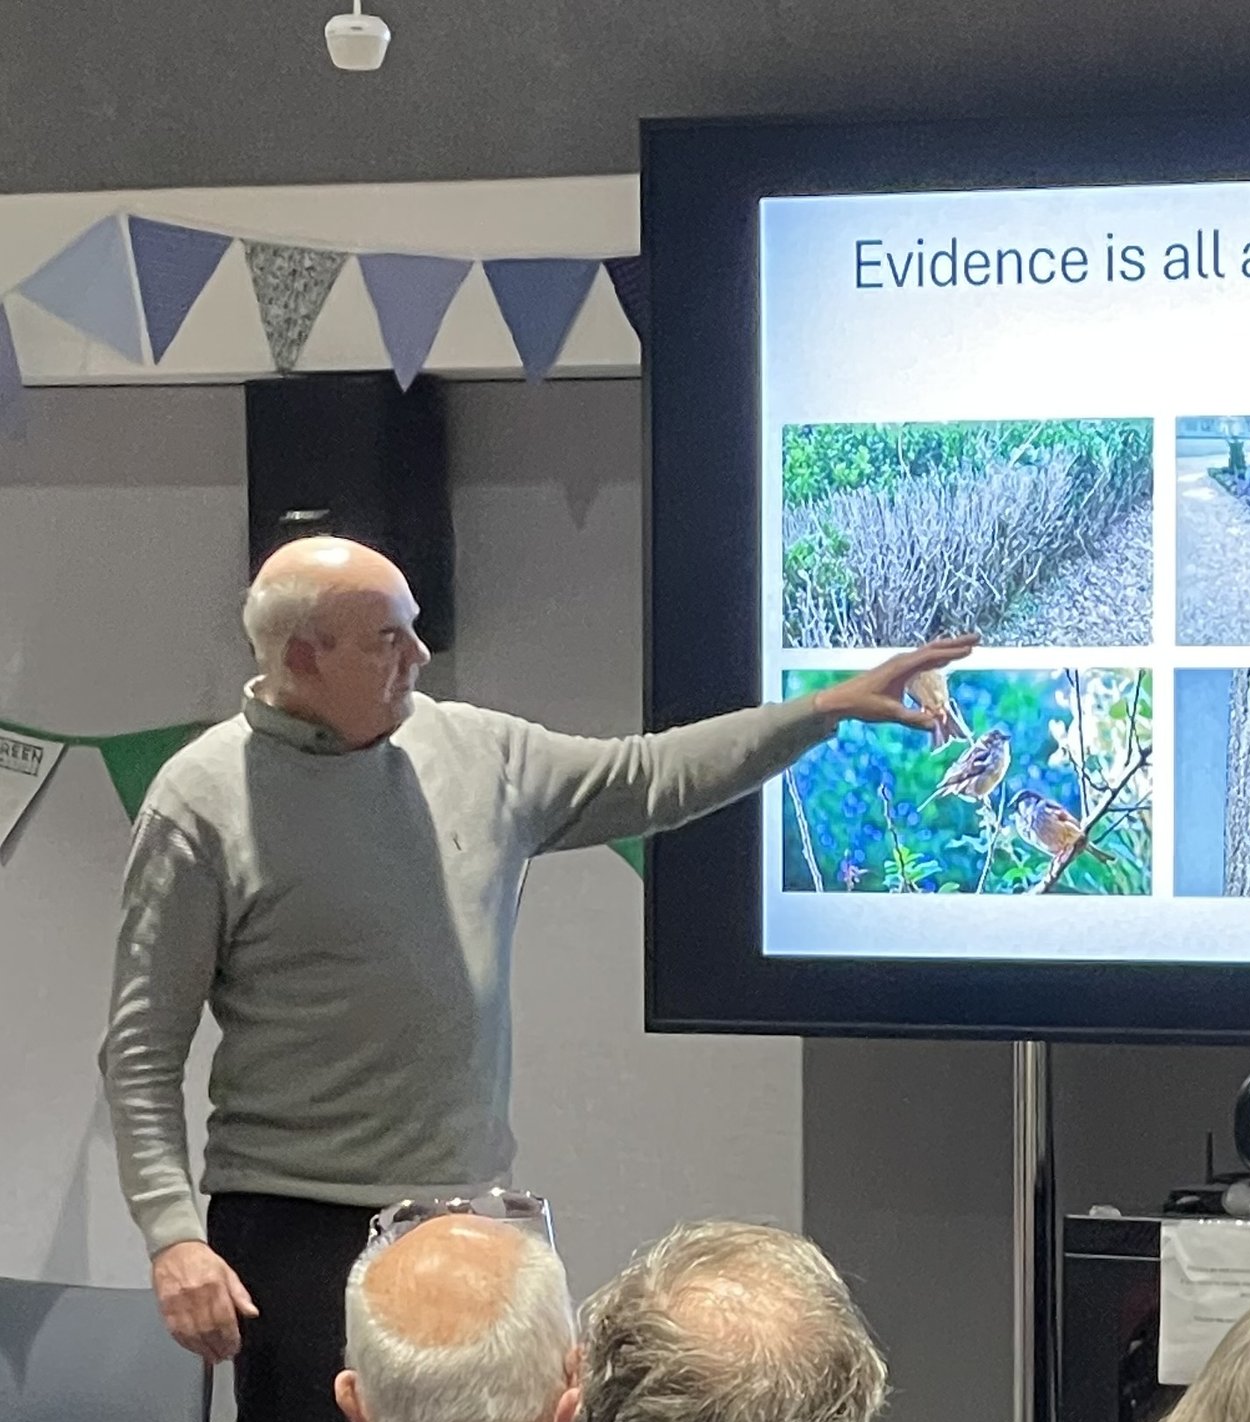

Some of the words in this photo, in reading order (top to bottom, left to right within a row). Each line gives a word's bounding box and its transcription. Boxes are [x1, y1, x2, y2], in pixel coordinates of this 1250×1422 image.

[854, 237, 1089, 289] Evidence
[1106, 232, 1146, 282] is
[1163, 228, 1226, 281] all
[0, 742, 43, 764] REEN
